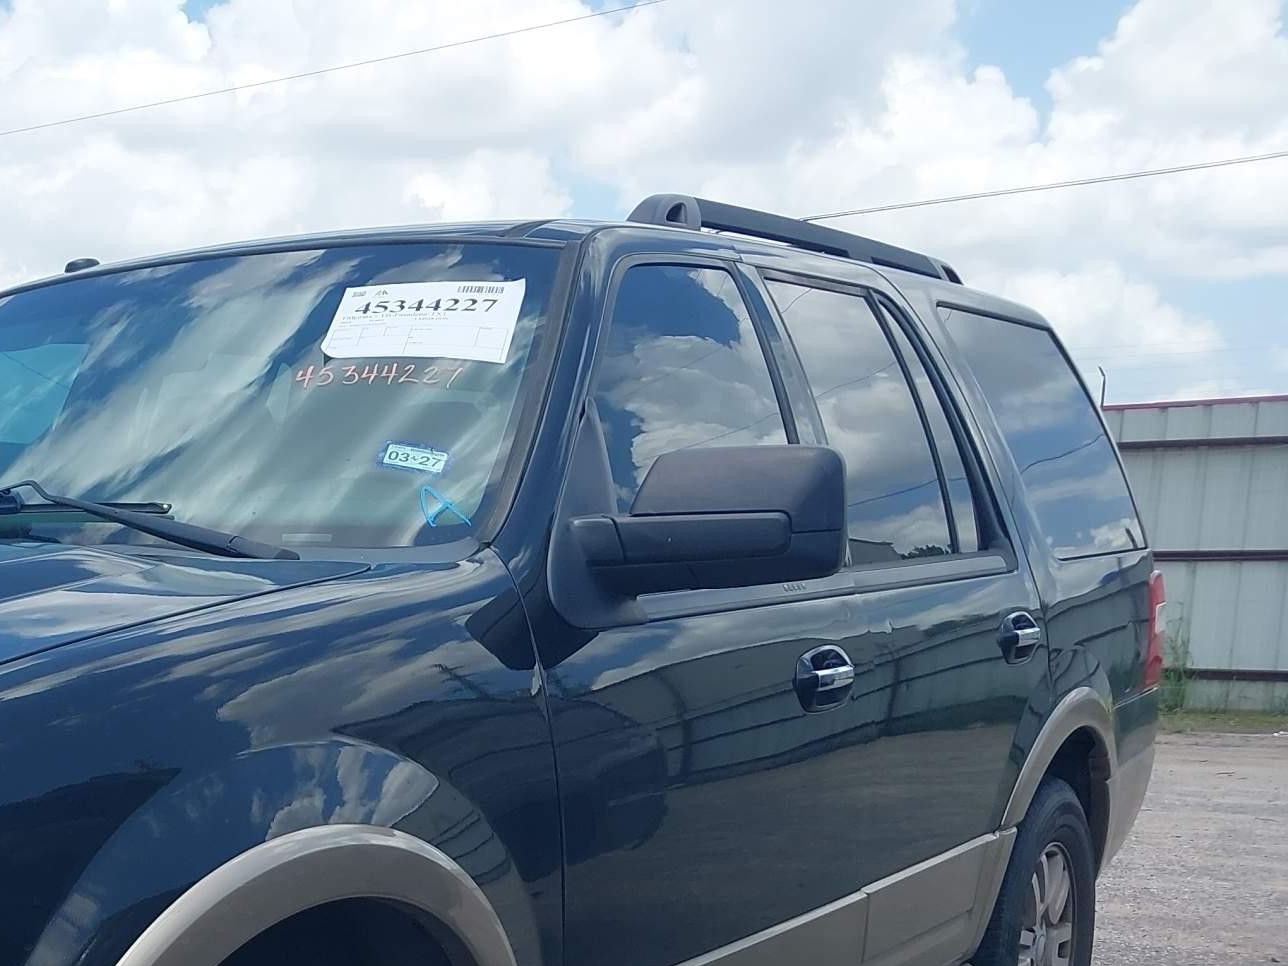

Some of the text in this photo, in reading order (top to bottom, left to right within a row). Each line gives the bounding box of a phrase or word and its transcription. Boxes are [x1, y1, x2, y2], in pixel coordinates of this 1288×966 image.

[354, 298, 499, 315] 45344227
[296, 362, 464, 389] 45344227
[388, 450, 410, 463] 03
[418, 455, 442, 468] 27
